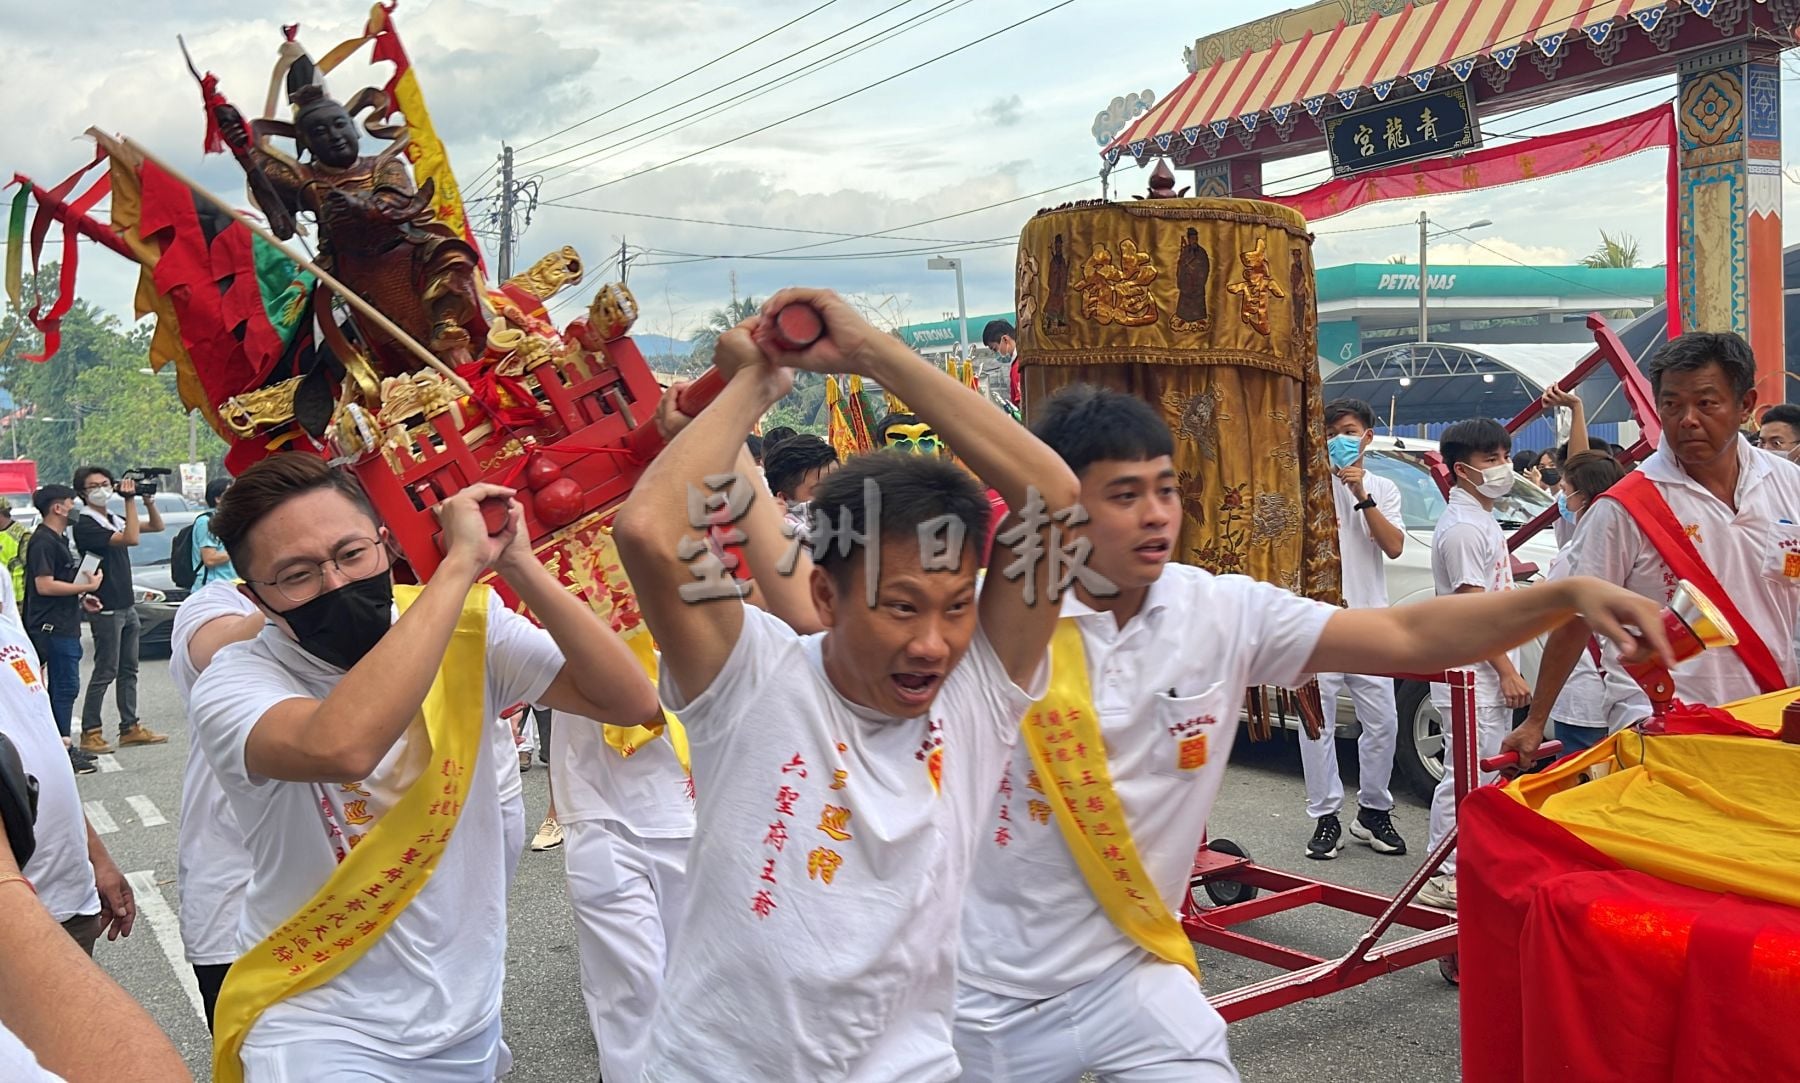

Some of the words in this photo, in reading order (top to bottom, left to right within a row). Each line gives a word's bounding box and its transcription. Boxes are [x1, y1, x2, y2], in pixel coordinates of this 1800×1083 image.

[1353, 107, 1439, 157] 青龍宮
[912, 327, 954, 342] PETRONAS
[750, 751, 807, 919] 六聖府王爺
[994, 760, 1014, 847] 府王爺
[272, 828, 436, 963] 六聖府王爺代天巡狩
